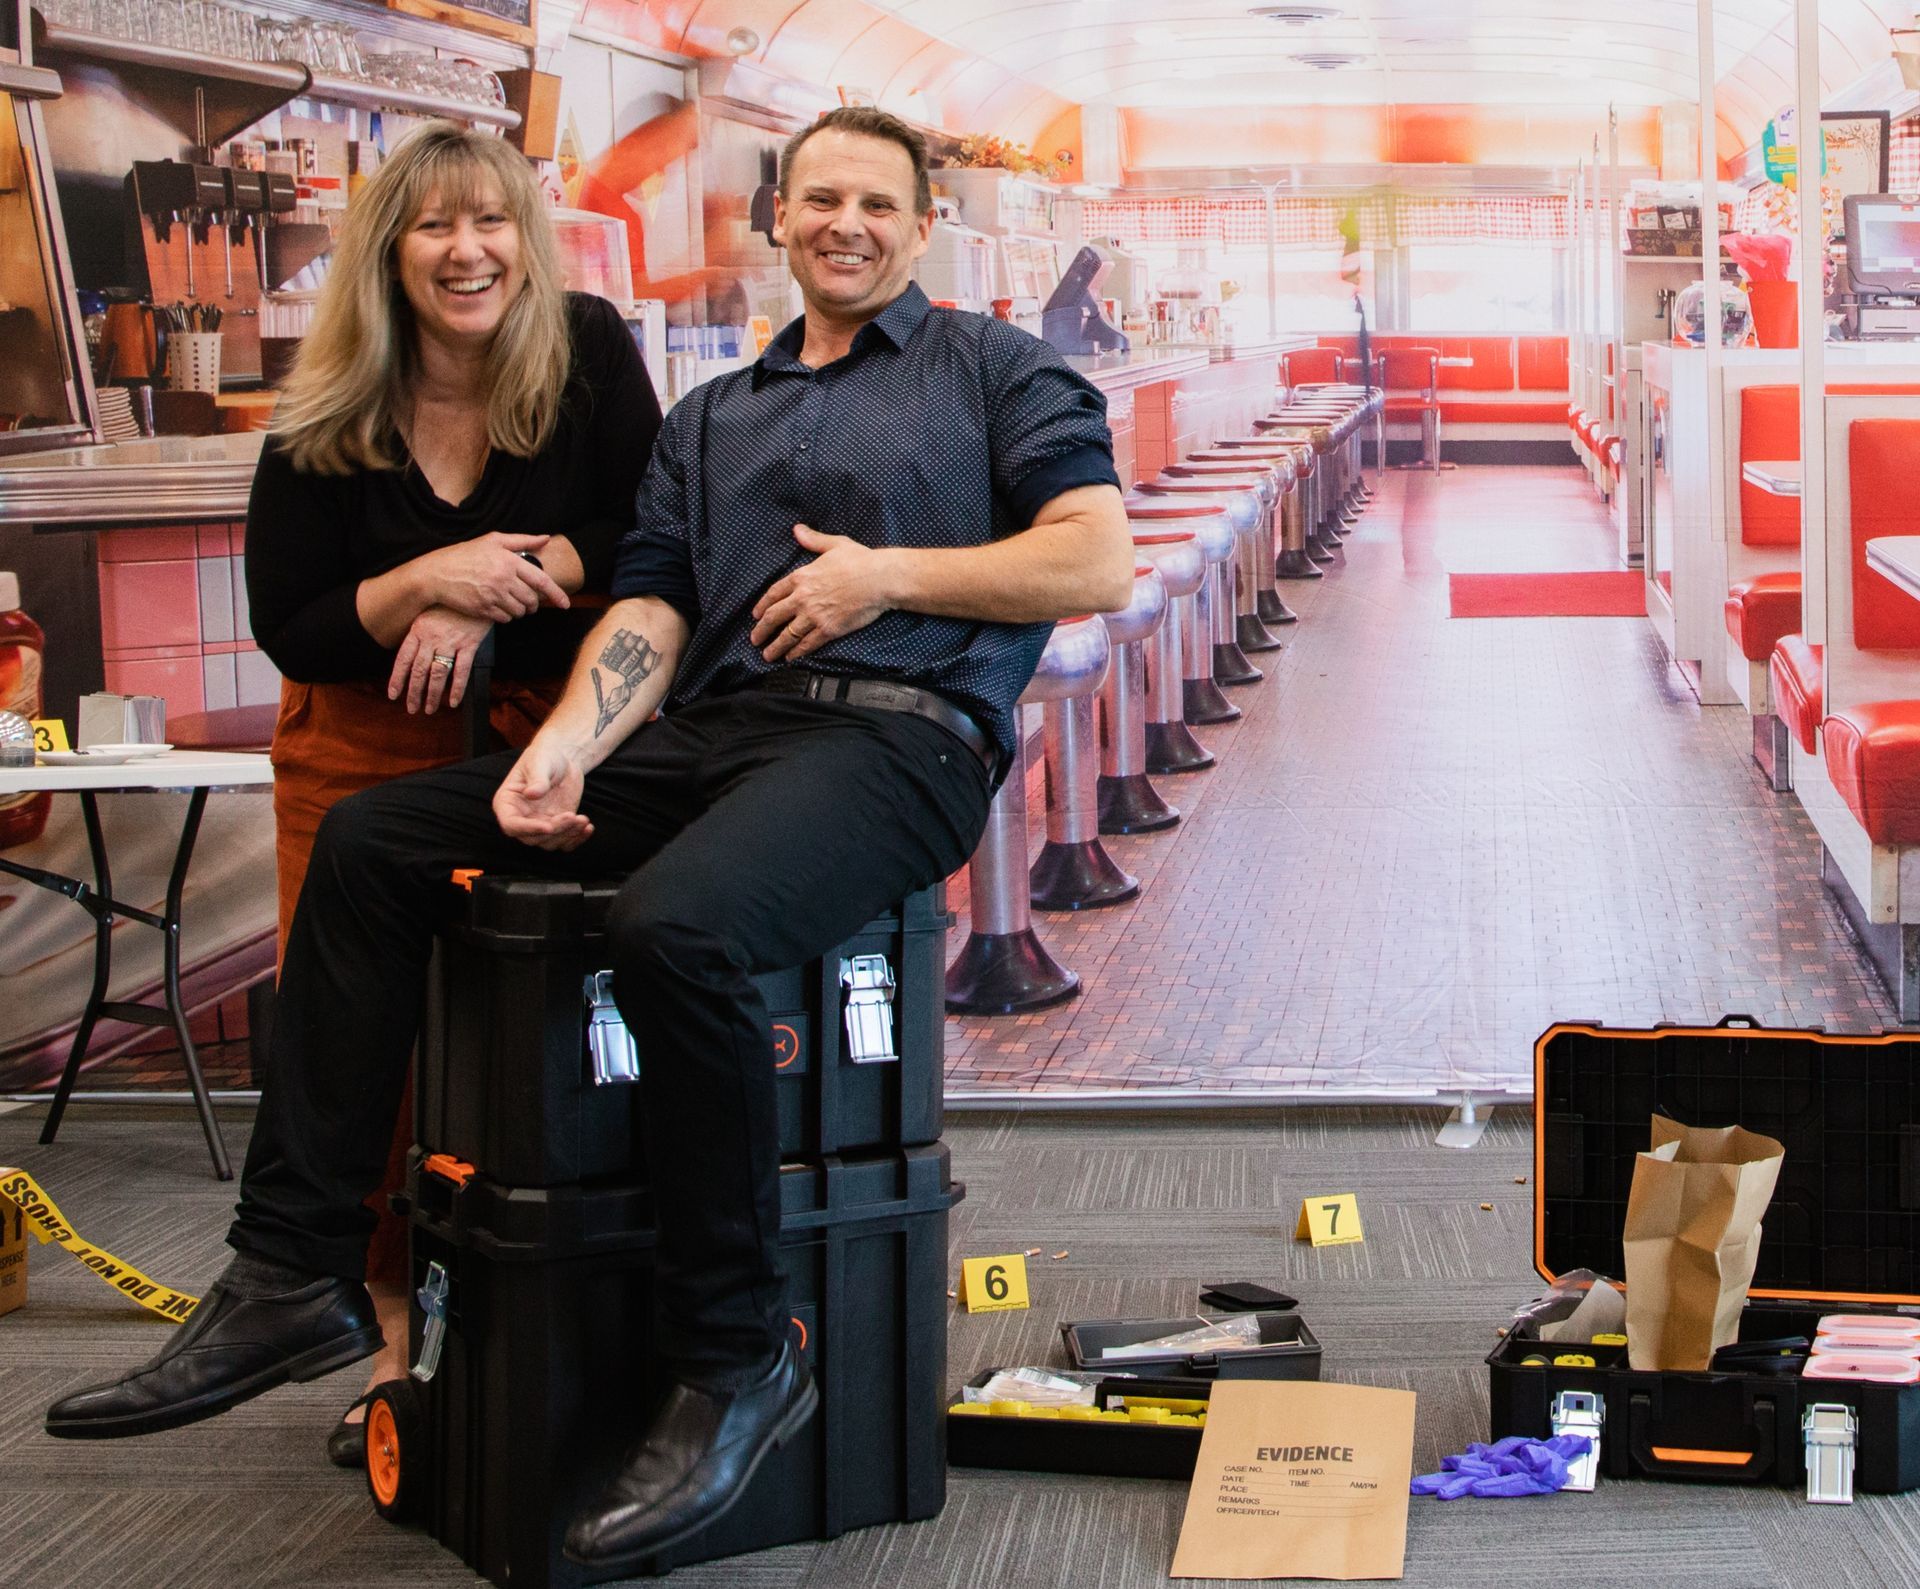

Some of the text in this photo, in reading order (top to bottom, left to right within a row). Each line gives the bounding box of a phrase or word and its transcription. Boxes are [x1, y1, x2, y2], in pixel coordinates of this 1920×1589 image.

[34, 726, 55, 752] 3
[1322, 1204, 1341, 1235] 7
[2, 1177, 198, 1319] NE DO NOT CROSS
[985, 1265, 1009, 1301] 6
[1256, 1445, 1355, 1463] EVIDENCE
[1224, 1465, 1248, 1473] CASE
[1288, 1467, 1325, 1476] ITEM NO.
[1222, 1475, 1245, 1483] DATE
[1220, 1484, 1248, 1493] PLACE
[1350, 1481, 1378, 1489] AM/PM
[1218, 1495, 1261, 1505] REMARKS
[1216, 1506, 1280, 1516] OFFICER/TECH
